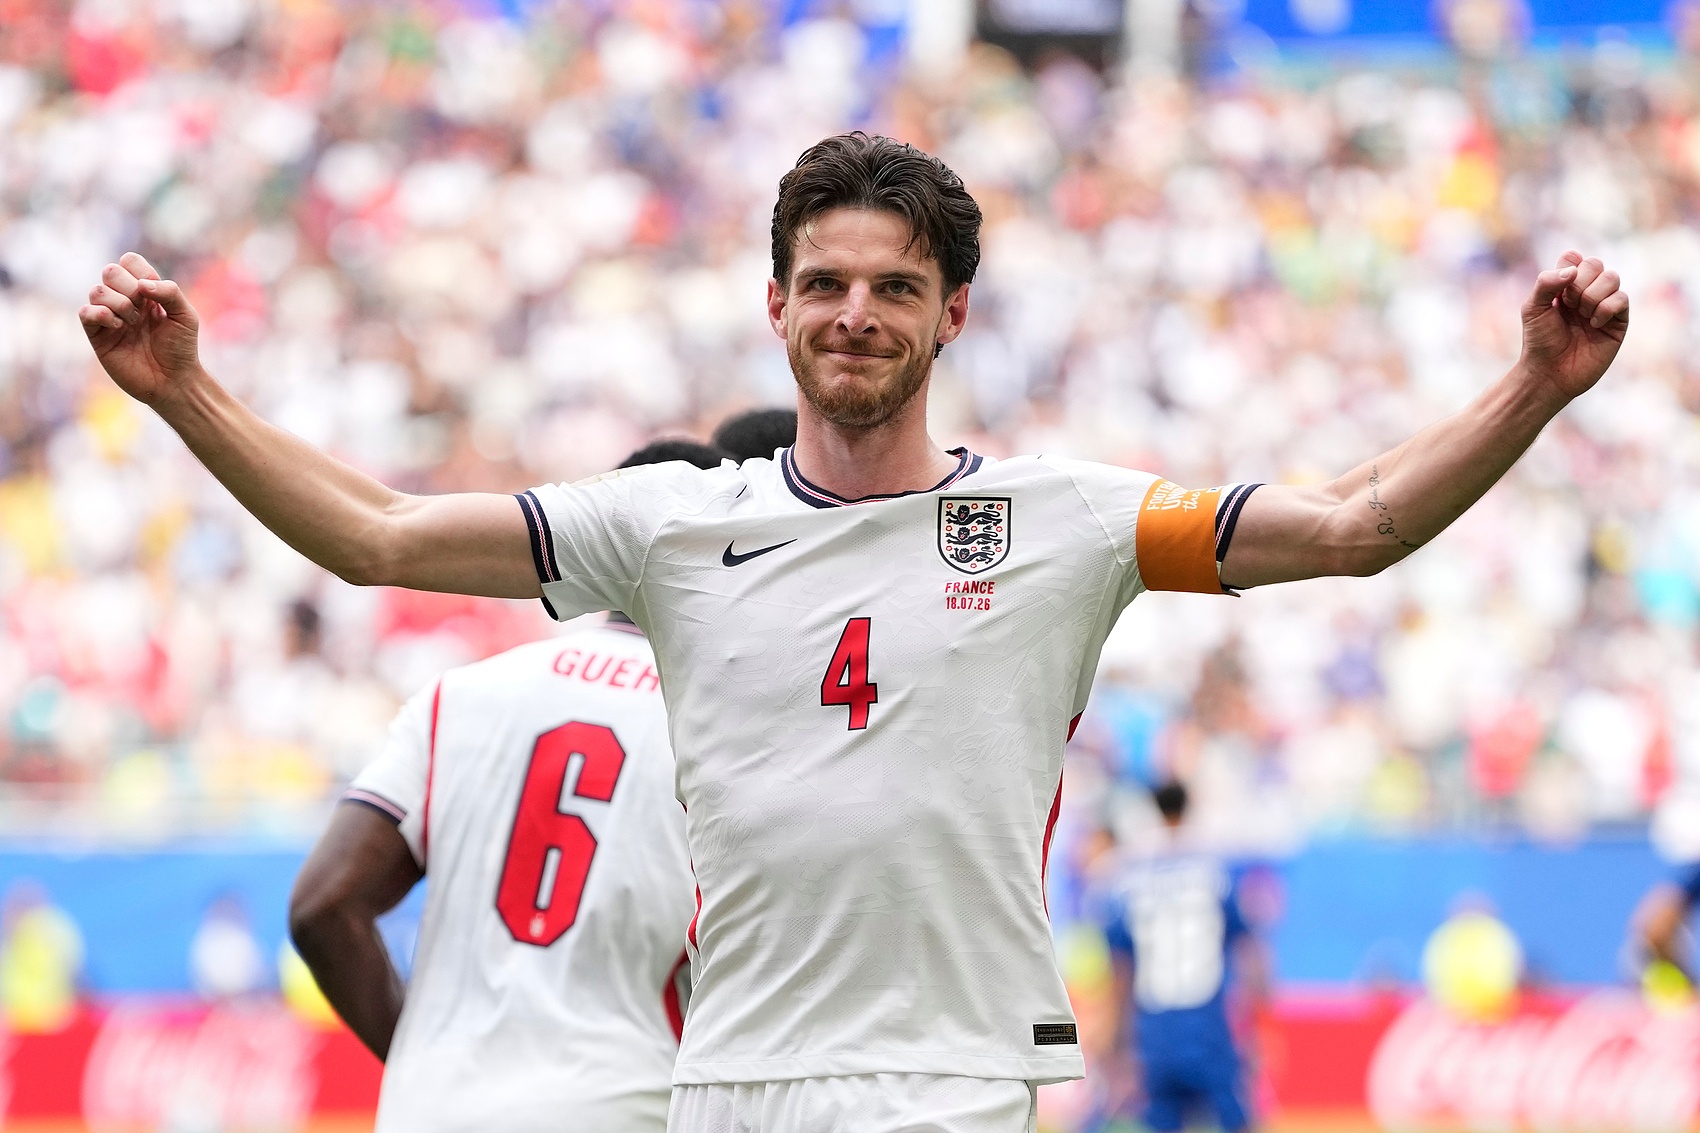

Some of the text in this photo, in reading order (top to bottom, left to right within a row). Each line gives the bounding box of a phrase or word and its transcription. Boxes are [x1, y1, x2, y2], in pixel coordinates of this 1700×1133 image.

[945, 580, 995, 594] FRANCE
[946, 596, 991, 611] 18.07.26
[821, 617, 878, 731] 4
[496, 720, 626, 947] 6
